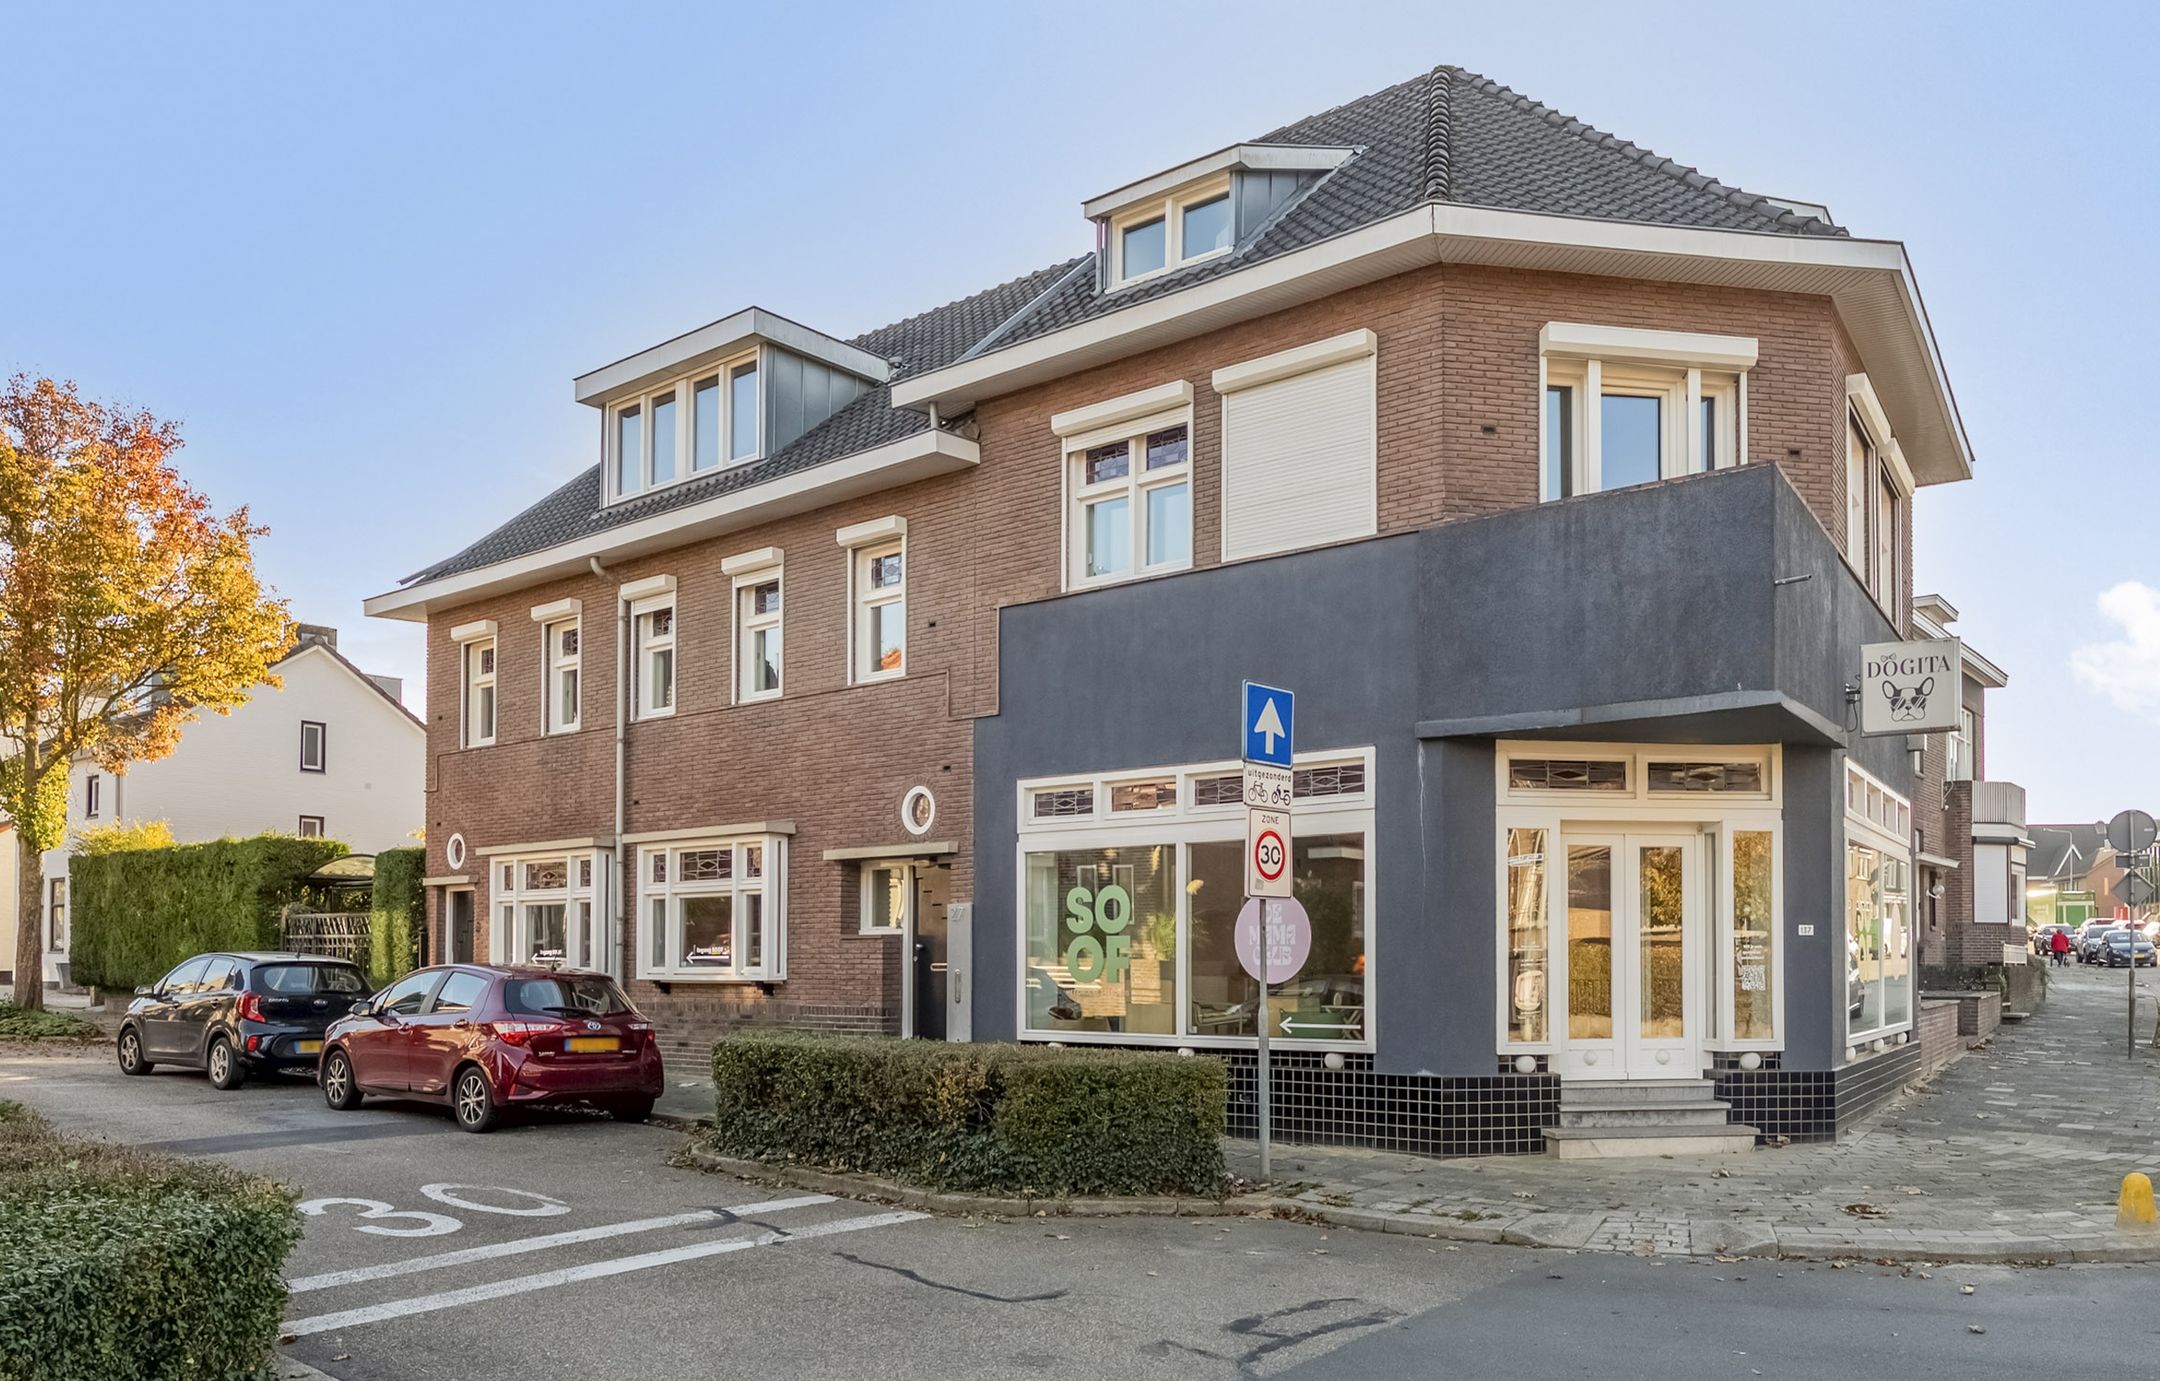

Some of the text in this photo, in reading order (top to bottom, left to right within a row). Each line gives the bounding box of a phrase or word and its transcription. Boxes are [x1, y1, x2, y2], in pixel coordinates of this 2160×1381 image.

[1867, 655, 1952, 678] DOGITA
[1247, 768, 1292, 783] uitgezonderd
[1261, 814, 1280, 825] ZONE
[1260, 844, 1281, 865] 30
[951, 906, 965, 921] 27
[1066, 885, 1131, 934] SO
[1067, 935, 1131, 983] OF
[296, 1182, 572, 1237] 30
